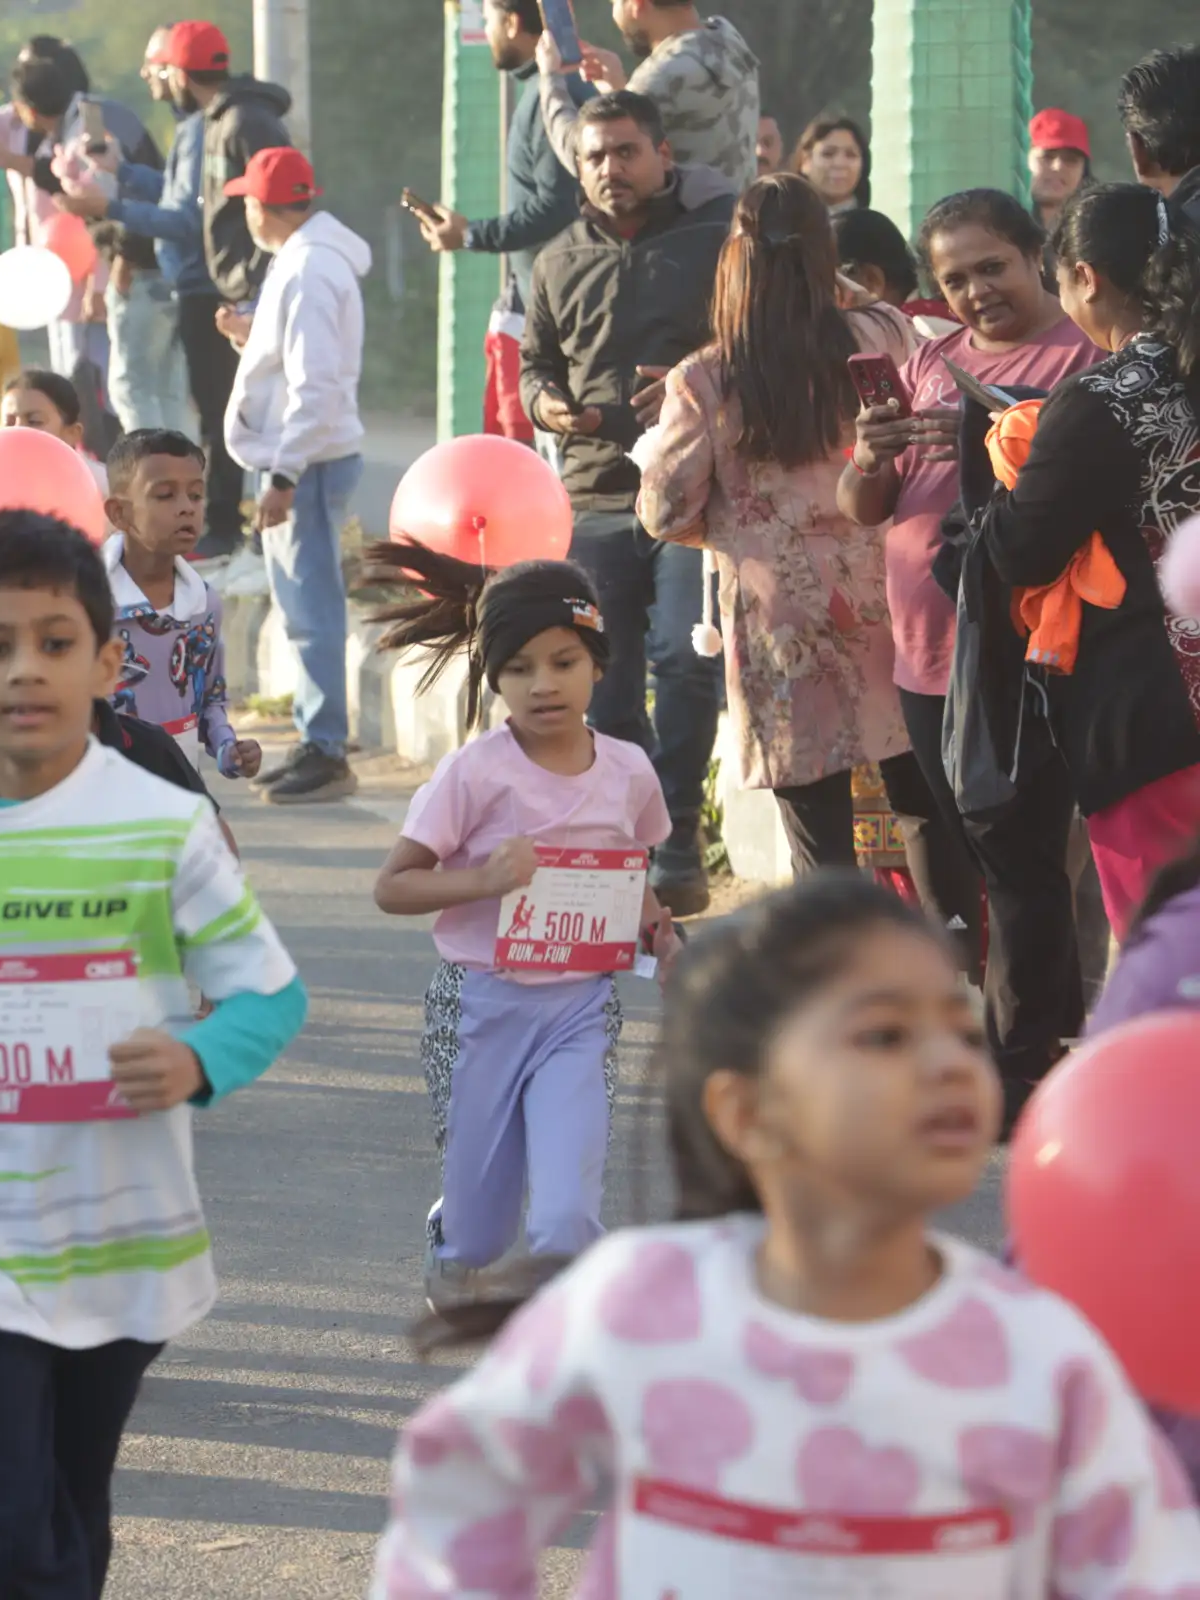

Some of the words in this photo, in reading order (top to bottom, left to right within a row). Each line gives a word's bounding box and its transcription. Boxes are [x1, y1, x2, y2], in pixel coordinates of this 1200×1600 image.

[2, 901, 75, 921] GIVE
[81, 898, 129, 919] UP
[544, 912, 585, 943] 500
[589, 916, 607, 944] M
[507, 943, 534, 962] RUN
[543, 945, 572, 964] FUN!
[46, 1045, 74, 1082] M
